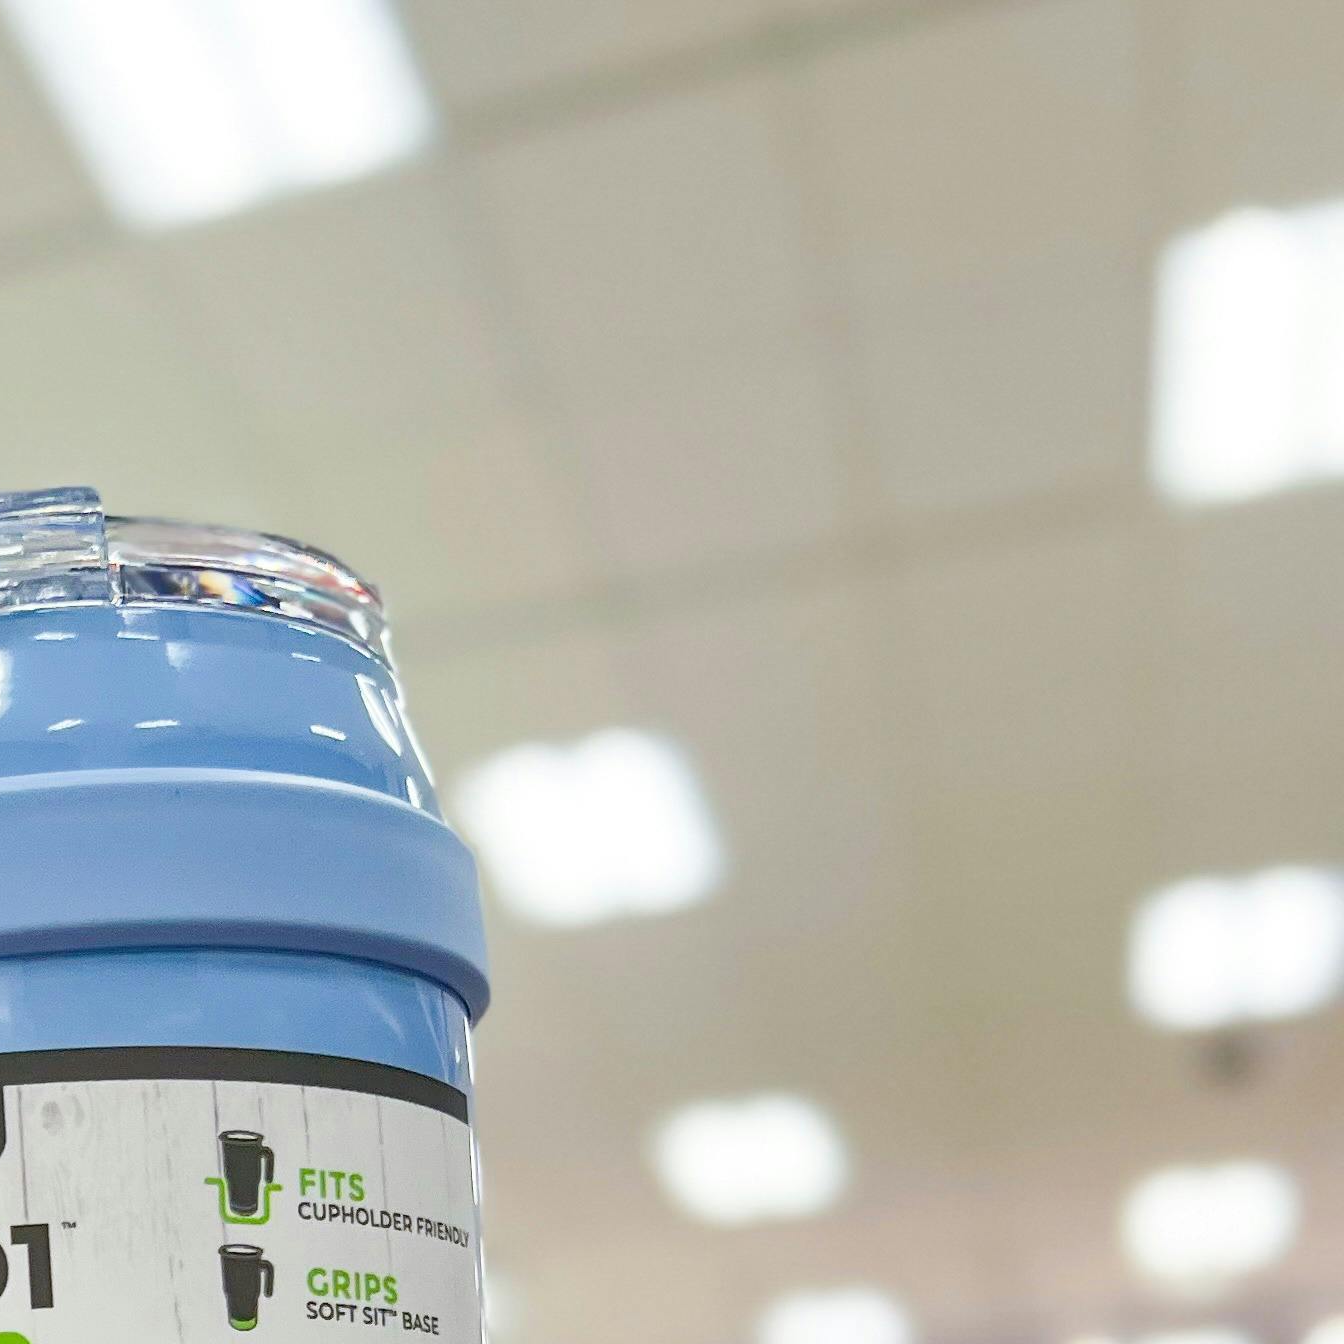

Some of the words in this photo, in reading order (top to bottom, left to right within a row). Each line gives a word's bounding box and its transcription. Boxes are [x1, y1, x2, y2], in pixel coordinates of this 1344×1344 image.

[299, 1168, 365, 1201] FITS
[298, 1202, 412, 1232] CUPHOLDER
[417, 1217, 470, 1248] FRIENDLY
[307, 1267, 399, 1304] GRIPS
[306, 1301, 357, 1323] SOFT
[402, 1312, 439, 1335] BASE
